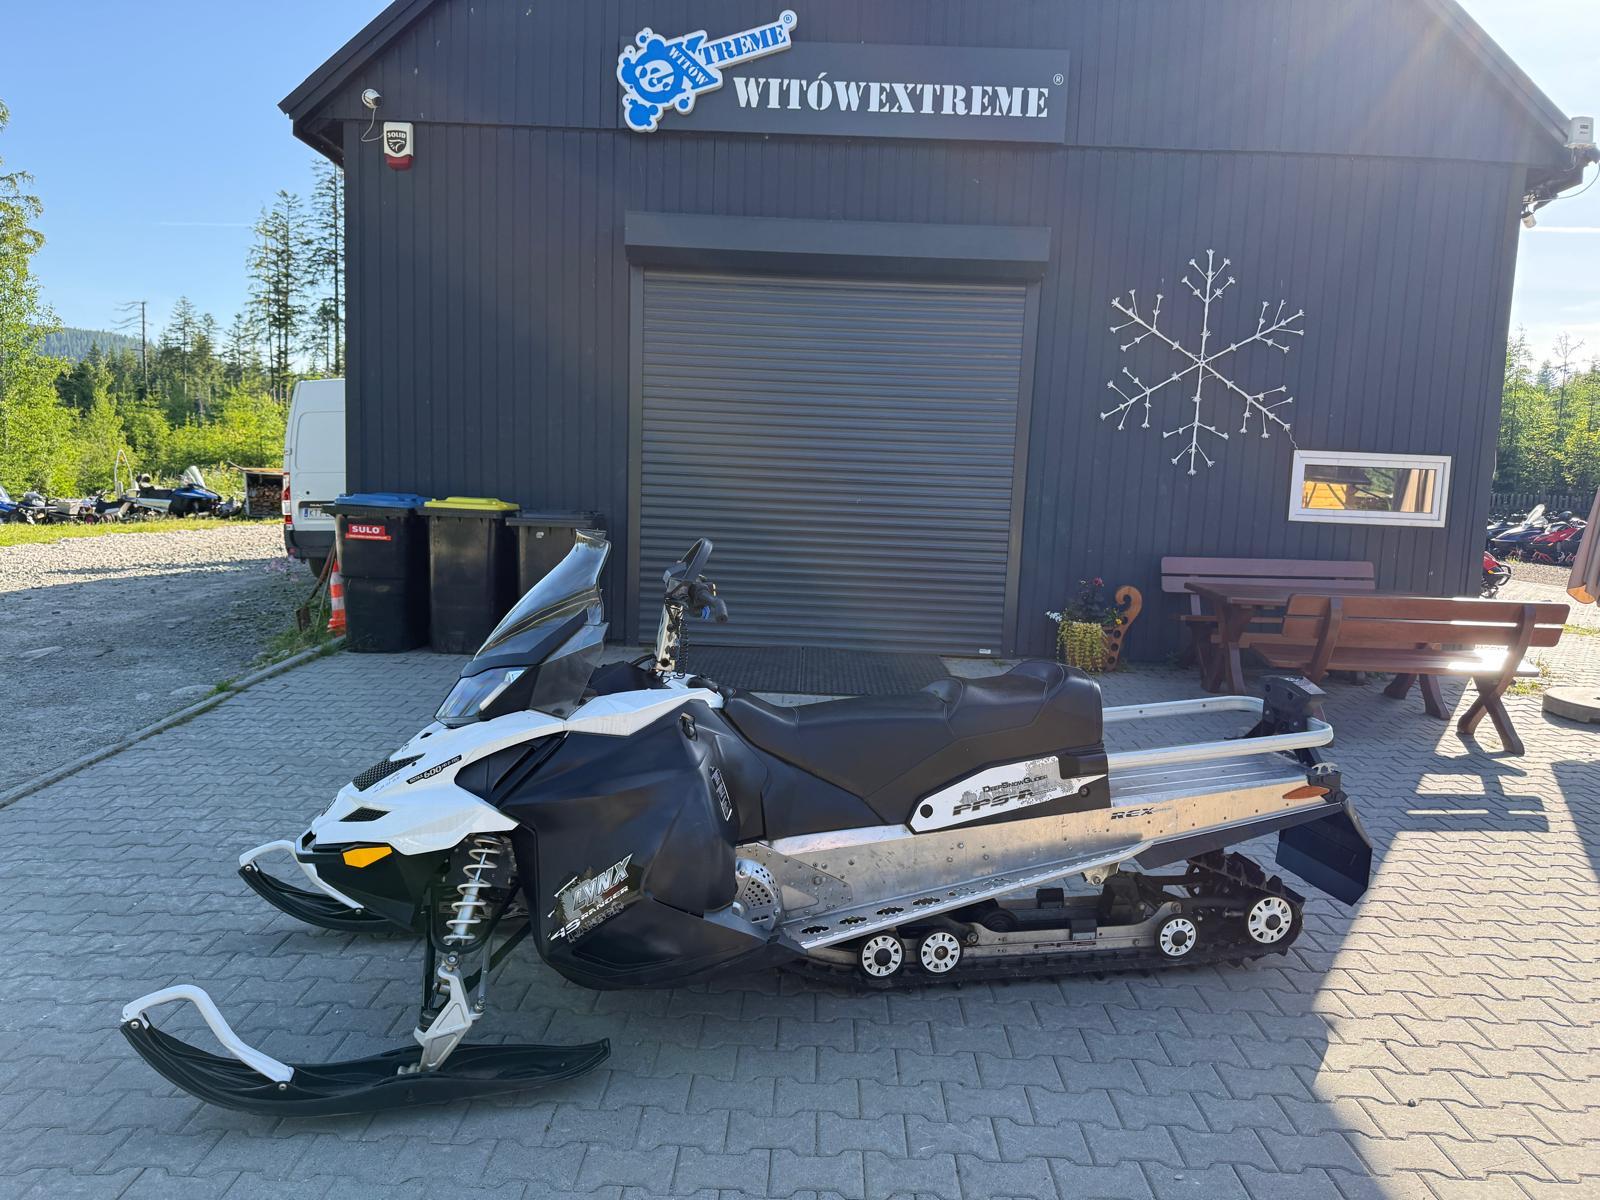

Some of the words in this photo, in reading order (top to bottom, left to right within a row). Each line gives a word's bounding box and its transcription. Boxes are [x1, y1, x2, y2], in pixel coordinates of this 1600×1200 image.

[668, 46, 710, 86] WITÓW
[733, 72, 1049, 117] WITÓWEXTREME
[387, 131, 406, 139] SOLID
[351, 525, 380, 534] SULO
[423, 765, 442, 779] 600
[1111, 807, 1154, 820] REX
[573, 853, 633, 912] LYNX
[550, 918, 581, 941] 49
[580, 886, 629, 920] RANGER
